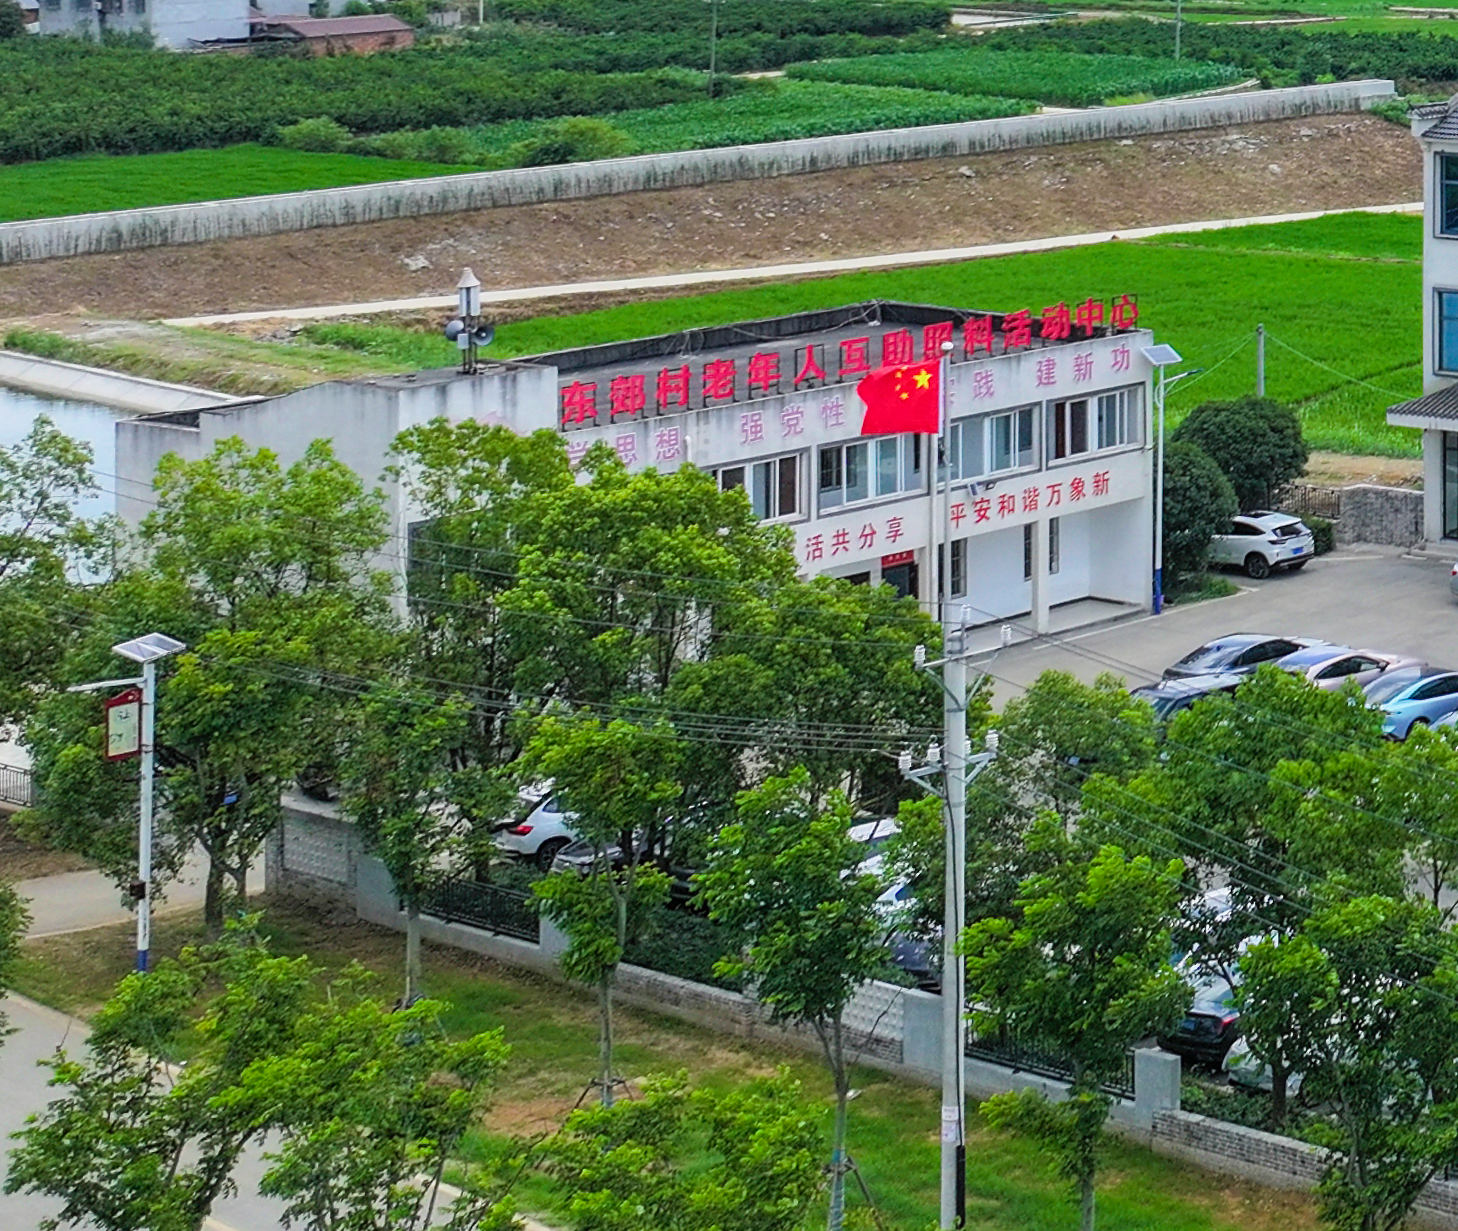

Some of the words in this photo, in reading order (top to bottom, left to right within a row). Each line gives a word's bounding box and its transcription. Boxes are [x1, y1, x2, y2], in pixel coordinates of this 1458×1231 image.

[560, 294, 1139, 425] 东郊村老年人互助照料活动中心
[741, 395, 846, 447] 强党性
[1035, 343, 1131, 388] 建新功
[950, 470, 1111, 529] 平安和谐万象新
